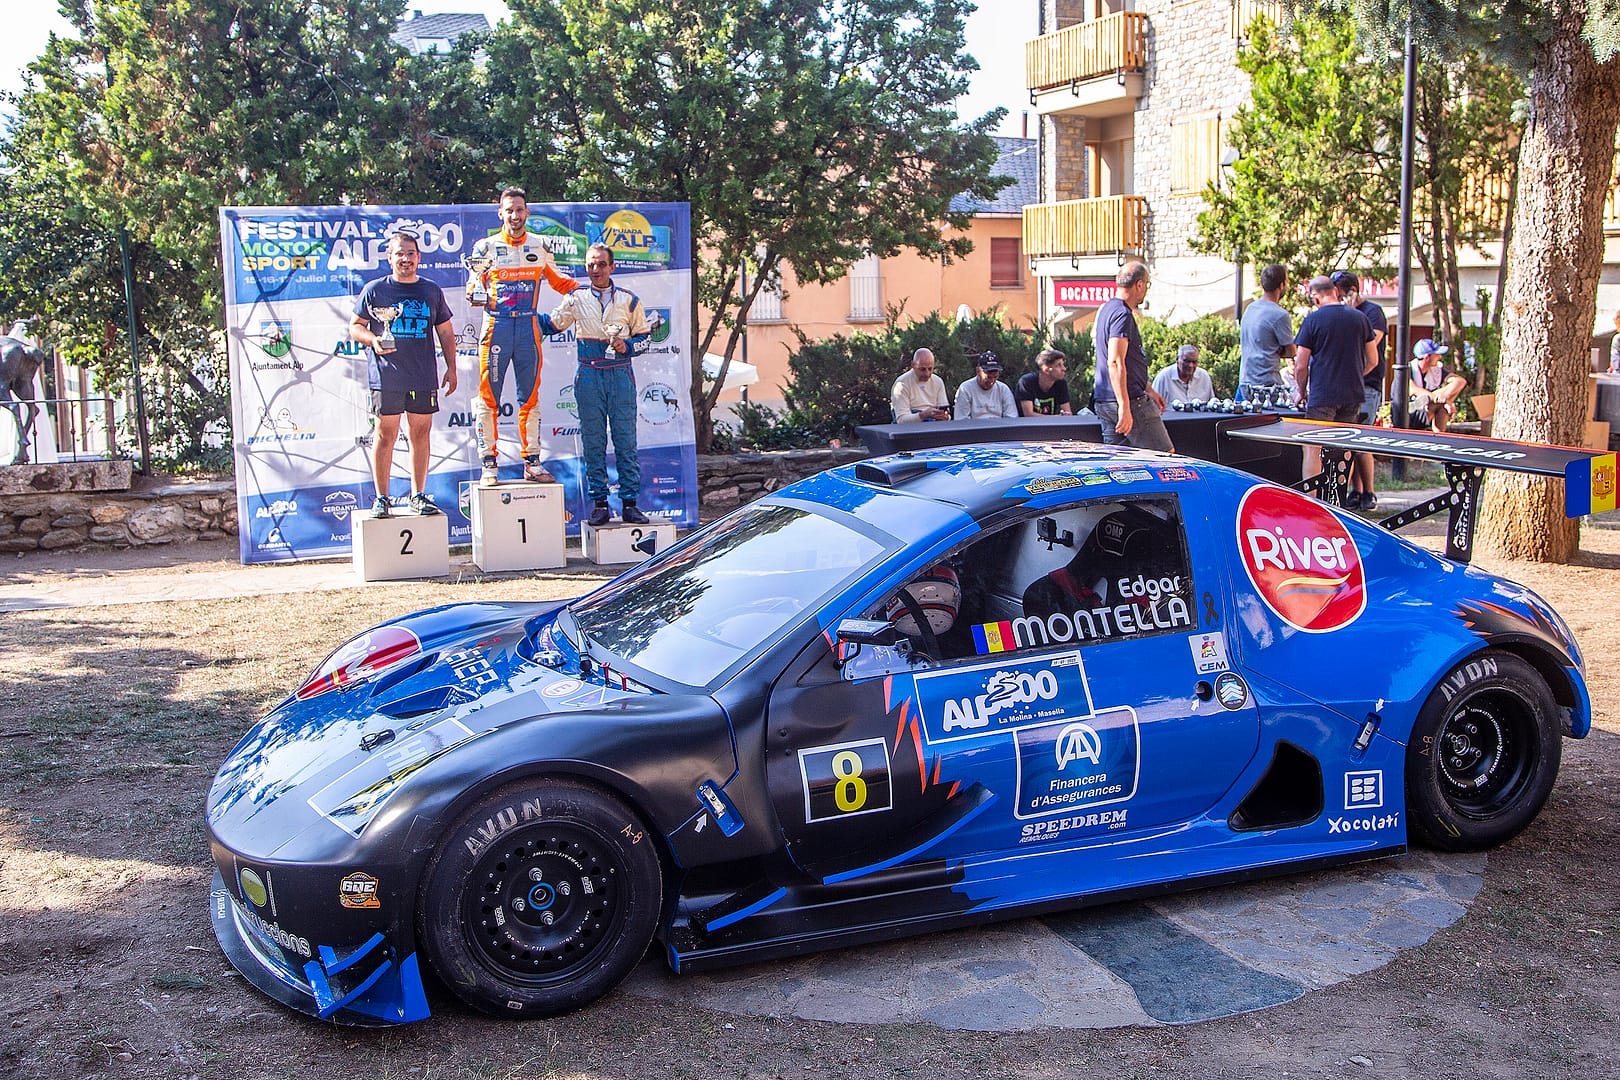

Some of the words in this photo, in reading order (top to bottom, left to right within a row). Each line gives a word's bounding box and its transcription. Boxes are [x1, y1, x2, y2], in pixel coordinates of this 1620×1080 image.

[241, 220, 377, 239] FESTIVAL
[242, 241, 327, 256] MOTOR
[242, 255, 320, 271] SPORT
[296, 274, 327, 283] Juliol
[391, 317, 428, 334] ALP
[253, 361, 292, 371] Ajuntament
[643, 389, 660, 402] AE
[247, 432, 317, 445] MICHELIN
[1355, 435, 1527, 461] SILVER-CAR
[517, 518, 527, 544] 1
[1104, 523, 1124, 538] OMP
[399, 529, 414, 555] 2
[1246, 525, 1347, 571] River
[1118, 574, 1182, 601] Edgar
[1199, 660, 1227, 672] CEM
[1439, 656, 1499, 702] AVON
[998, 716, 1007, 724] La
[1008, 713, 1033, 723] Molina
[1037, 708, 1065, 717] Masella
[831, 750, 868, 812] 8
[1049, 771, 1107, 791] Financera
[1031, 783, 1122, 809] d'Assegurances
[464, 797, 543, 857] AVON
[1021, 809, 1128, 837] SPEEDREM
[1108, 820, 1127, 830] .com
[1328, 812, 1398, 834] Xocolatí
[620, 823, 643, 845] A-8
